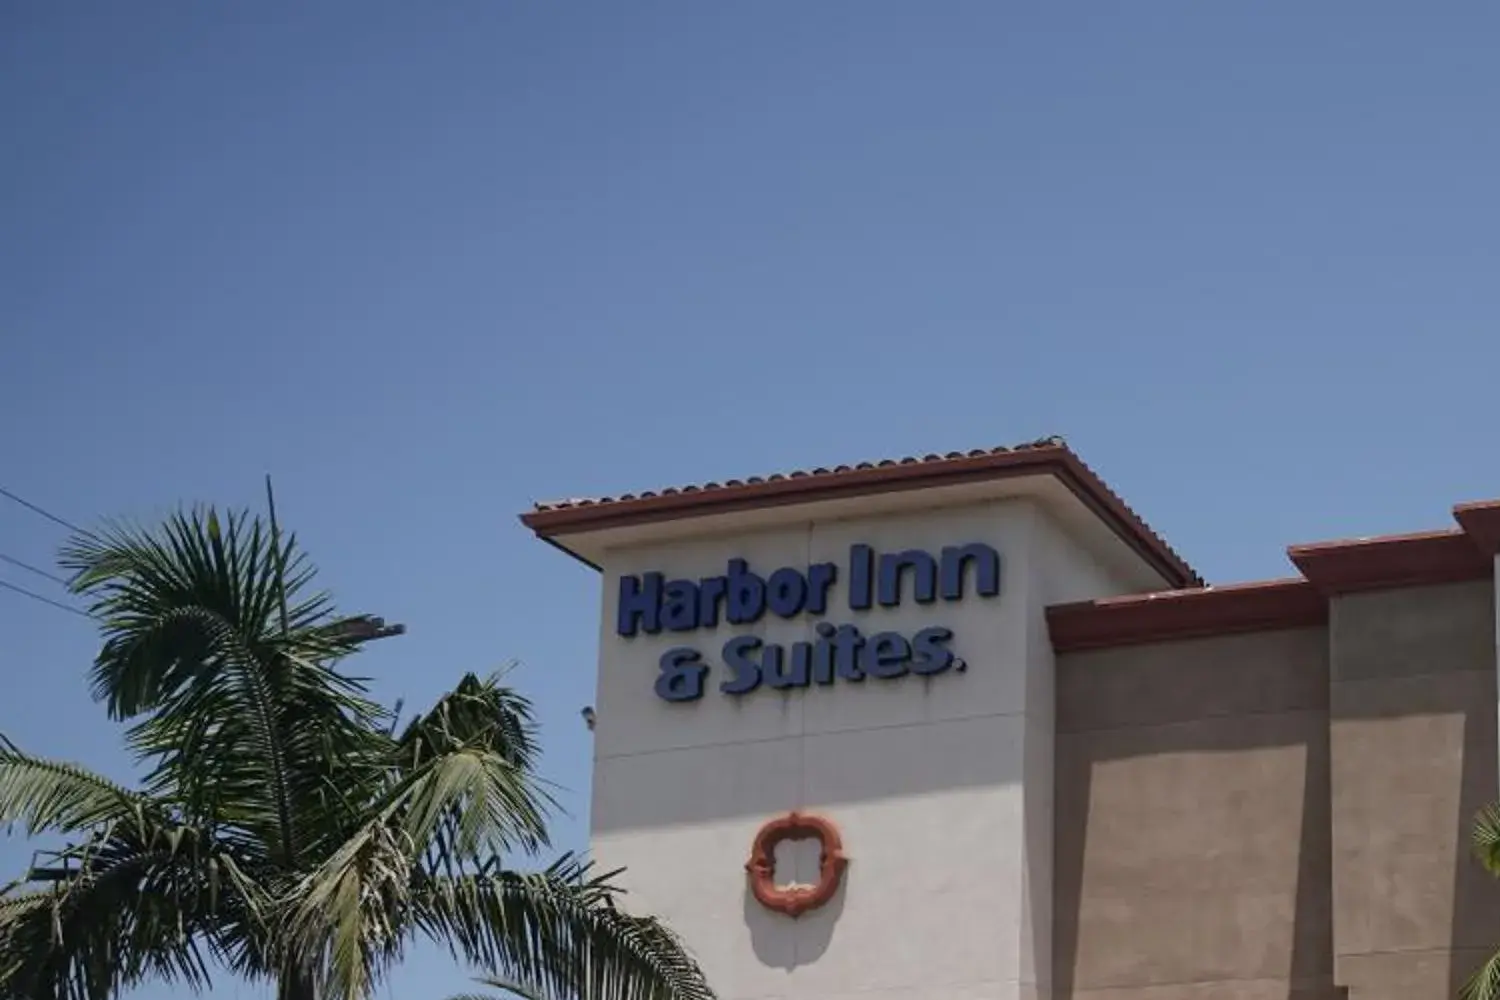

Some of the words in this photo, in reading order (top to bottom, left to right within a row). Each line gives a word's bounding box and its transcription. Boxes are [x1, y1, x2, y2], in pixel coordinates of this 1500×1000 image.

[617, 557, 838, 637] Harbor
[848, 543, 1001, 610] Inn
[654, 646, 711, 701] &
